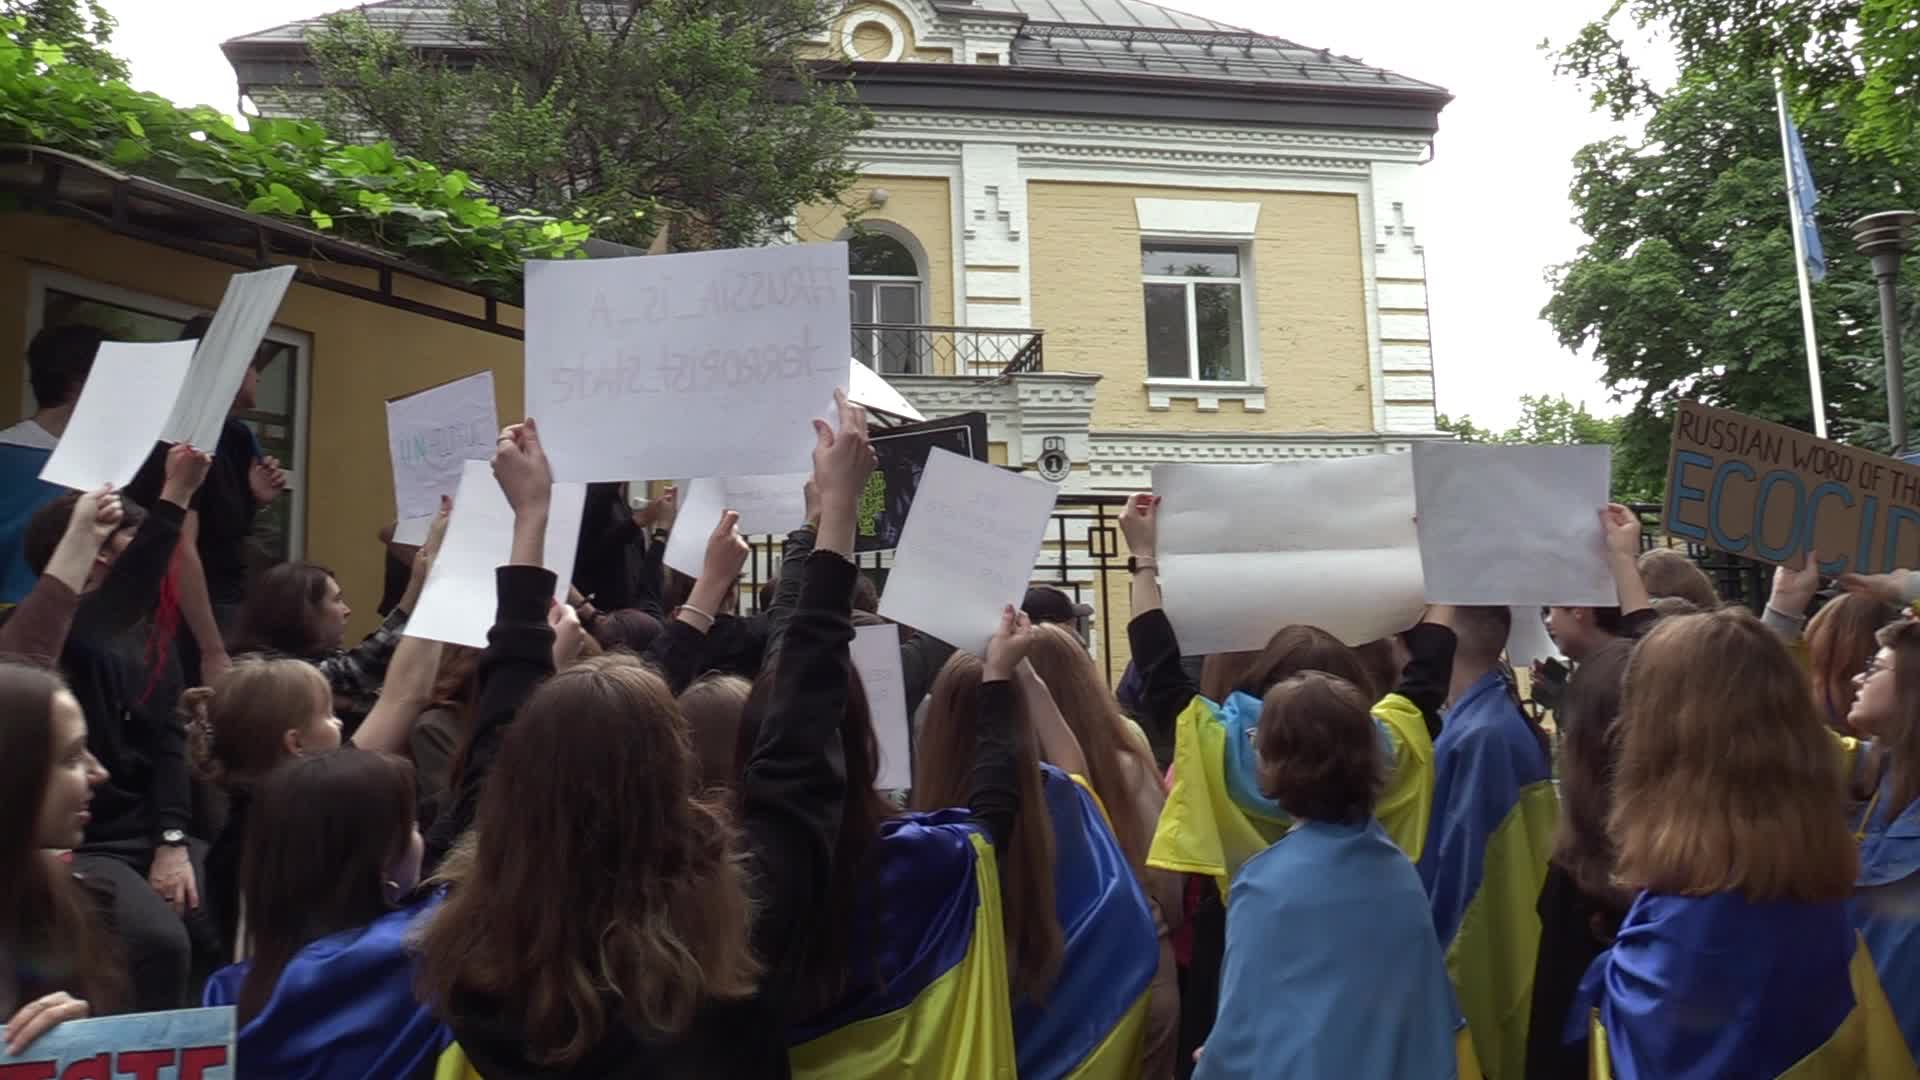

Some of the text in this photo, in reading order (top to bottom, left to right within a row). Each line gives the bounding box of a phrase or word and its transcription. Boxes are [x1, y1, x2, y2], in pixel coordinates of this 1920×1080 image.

[1678, 410, 1920, 506] RUSSIAN WORD OF TH
